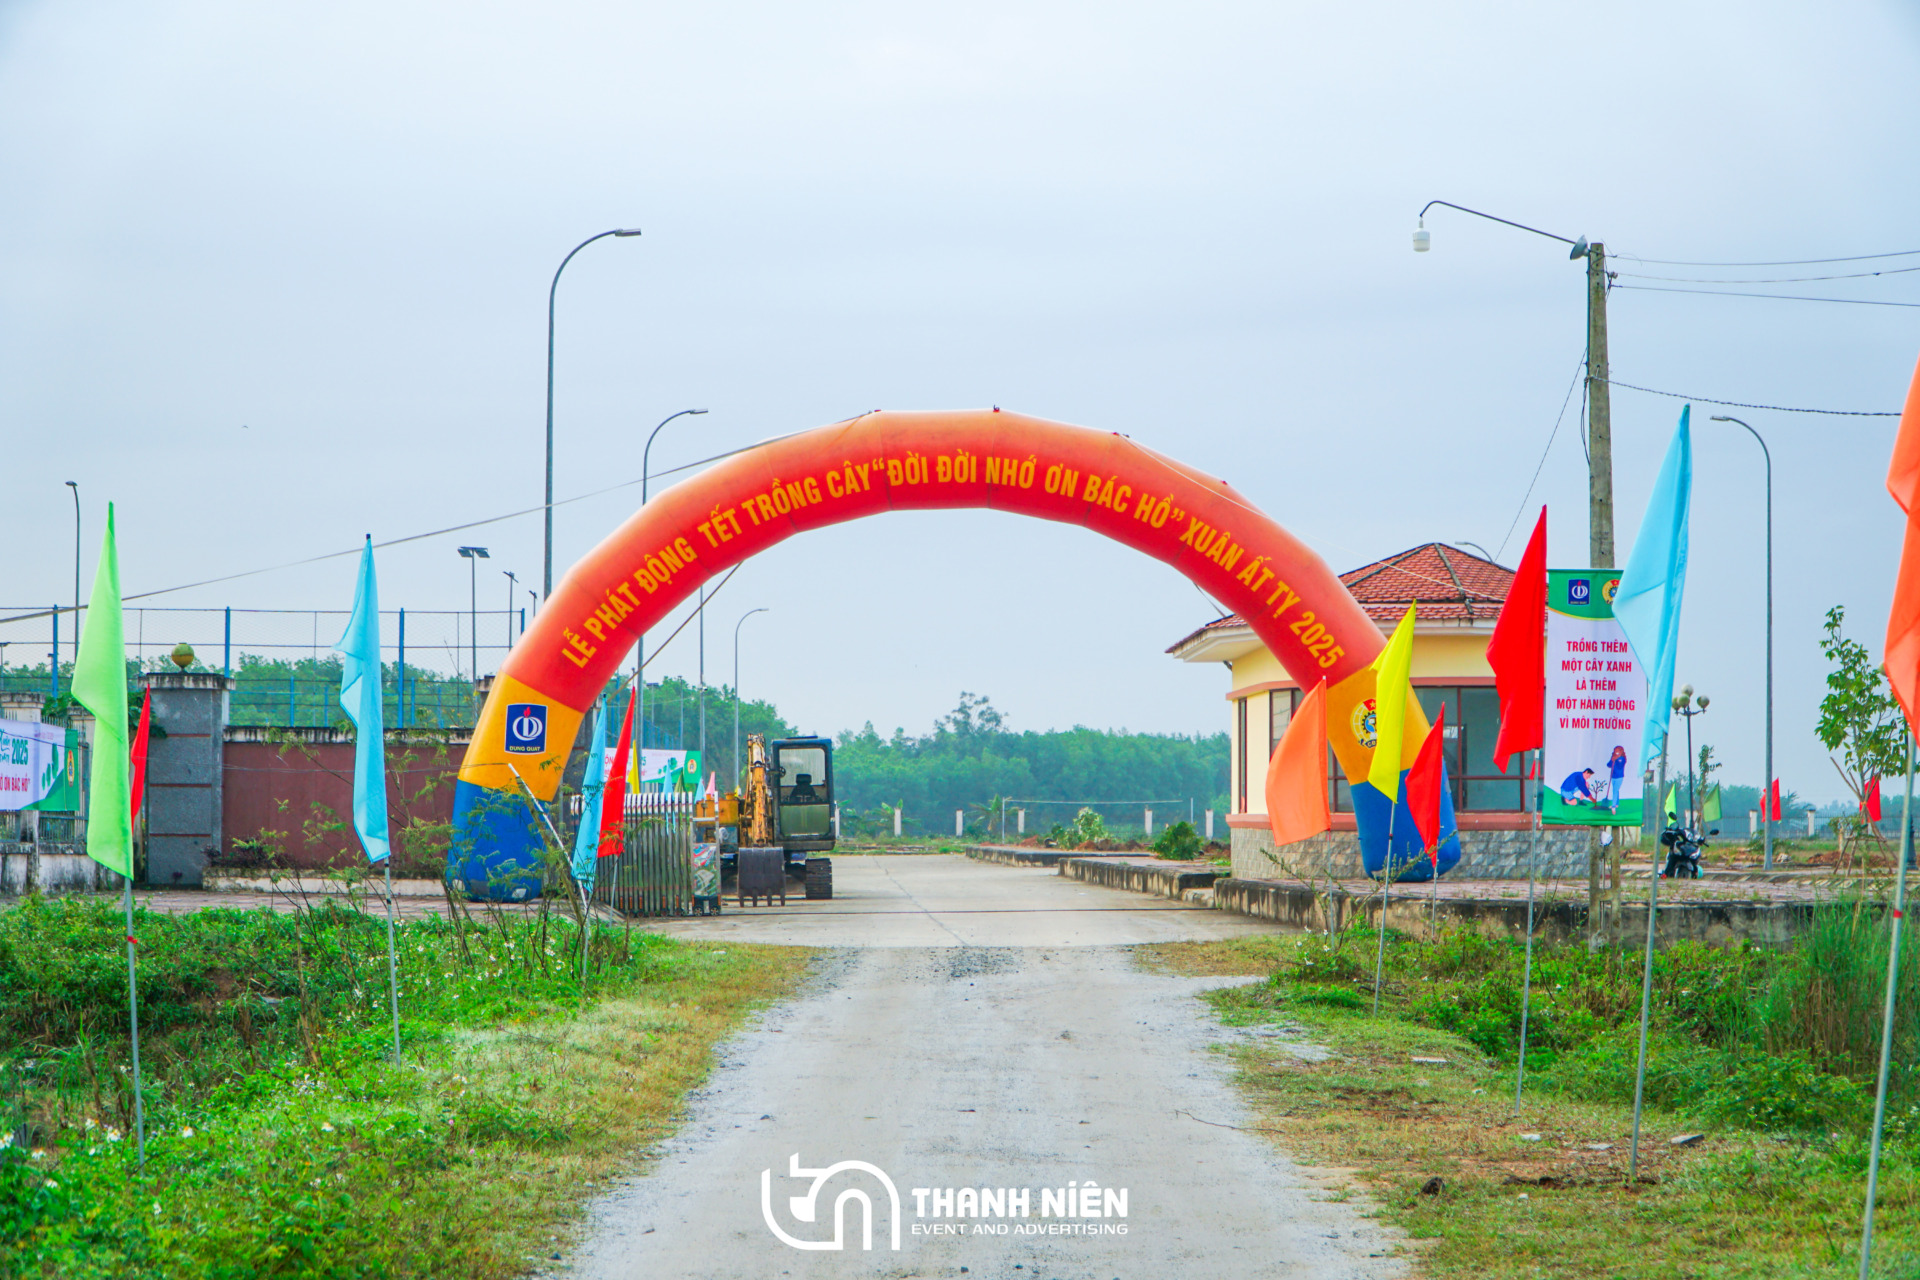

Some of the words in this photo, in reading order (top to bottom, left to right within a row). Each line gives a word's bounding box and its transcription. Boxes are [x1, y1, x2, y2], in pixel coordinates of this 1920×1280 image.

[562, 627, 597, 669] LỄ
[583, 581, 641, 642] PHÁT
[633, 537, 698, 595] ĐỘNG
[697, 503, 743, 548] TẾT
[741, 478, 822, 526] TRỒNG
[826, 460, 870, 498] CÂY
[936, 449, 976, 483] ĐỜI
[985, 454, 1037, 489] NHỚ
[1044, 463, 1079, 497] ƠN
[1082, 475, 1132, 513] BÁC
[1179, 517, 1244, 572] XUÂN
[1236, 555, 1275, 592] ẤT
[1266, 580, 1301, 619] TỴ
[1289, 611, 1345, 668] 2025
[1601, 638, 1628, 653] THÊM
[1561, 657, 1583, 674] MỘT
[1585, 657, 1604, 672] CÂY
[1606, 660, 1632, 672] XANH
[1576, 676, 1587, 691] LÀ
[1590, 676, 1616, 691] THÊM
[1556, 695, 1577, 712] MỘT
[1580, 695, 1606, 710] HÀNH
[1608, 696, 1635, 713] ĐỘNG
[1559, 715, 1569, 729] VÌ
[1572, 715, 1590, 729] MÔI
[1593, 715, 1632, 730] TRƯỜNG
[12, 738, 28, 766] 2025
